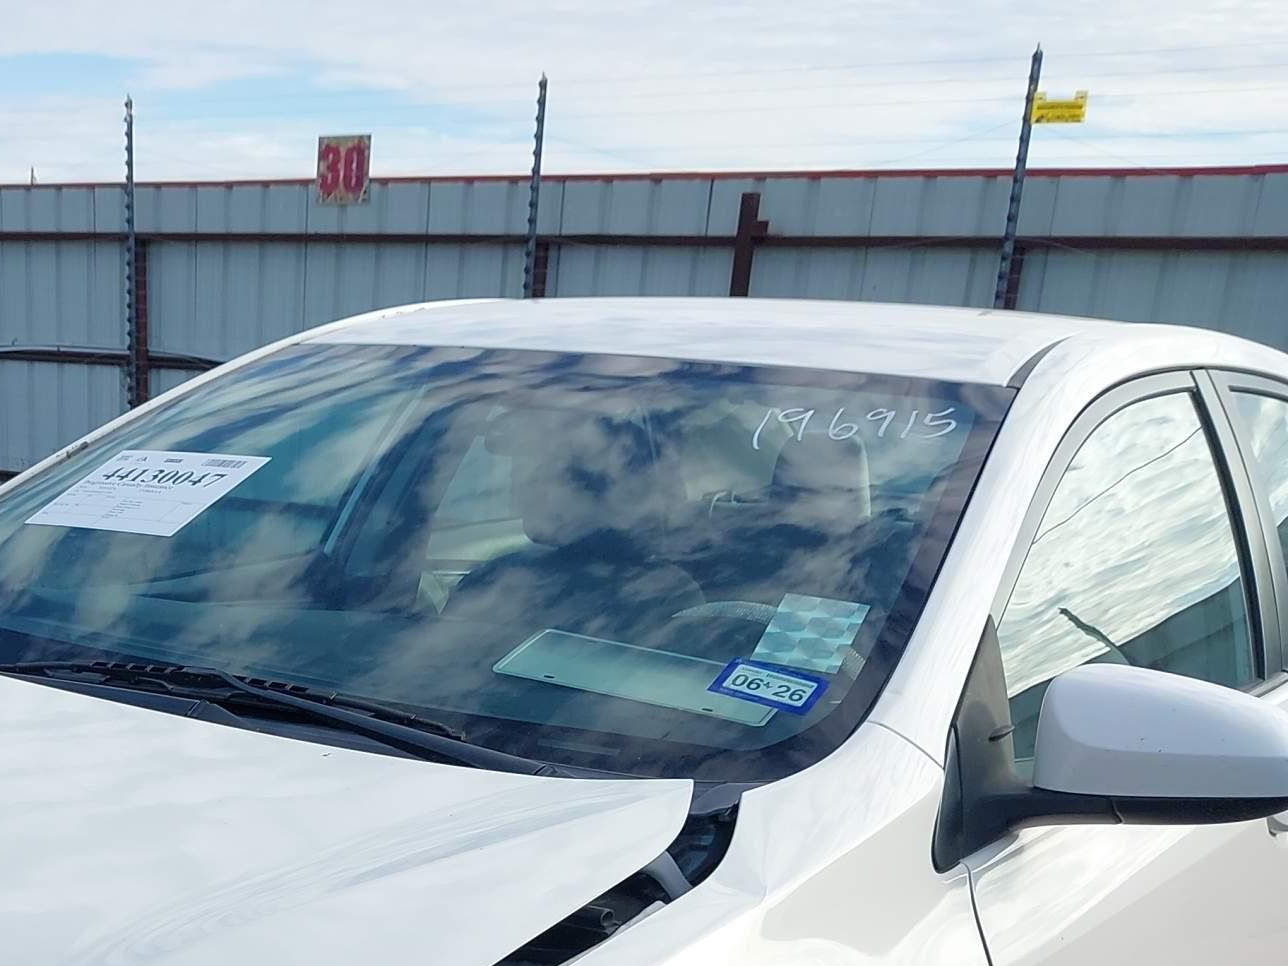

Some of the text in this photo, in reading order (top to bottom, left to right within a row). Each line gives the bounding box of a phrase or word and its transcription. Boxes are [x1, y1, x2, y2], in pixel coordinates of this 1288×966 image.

[319, 143, 366, 193] 30
[102, 467, 229, 488] 44130047
[731, 673, 764, 691] 06
[772, 684, 807, 702] 26
